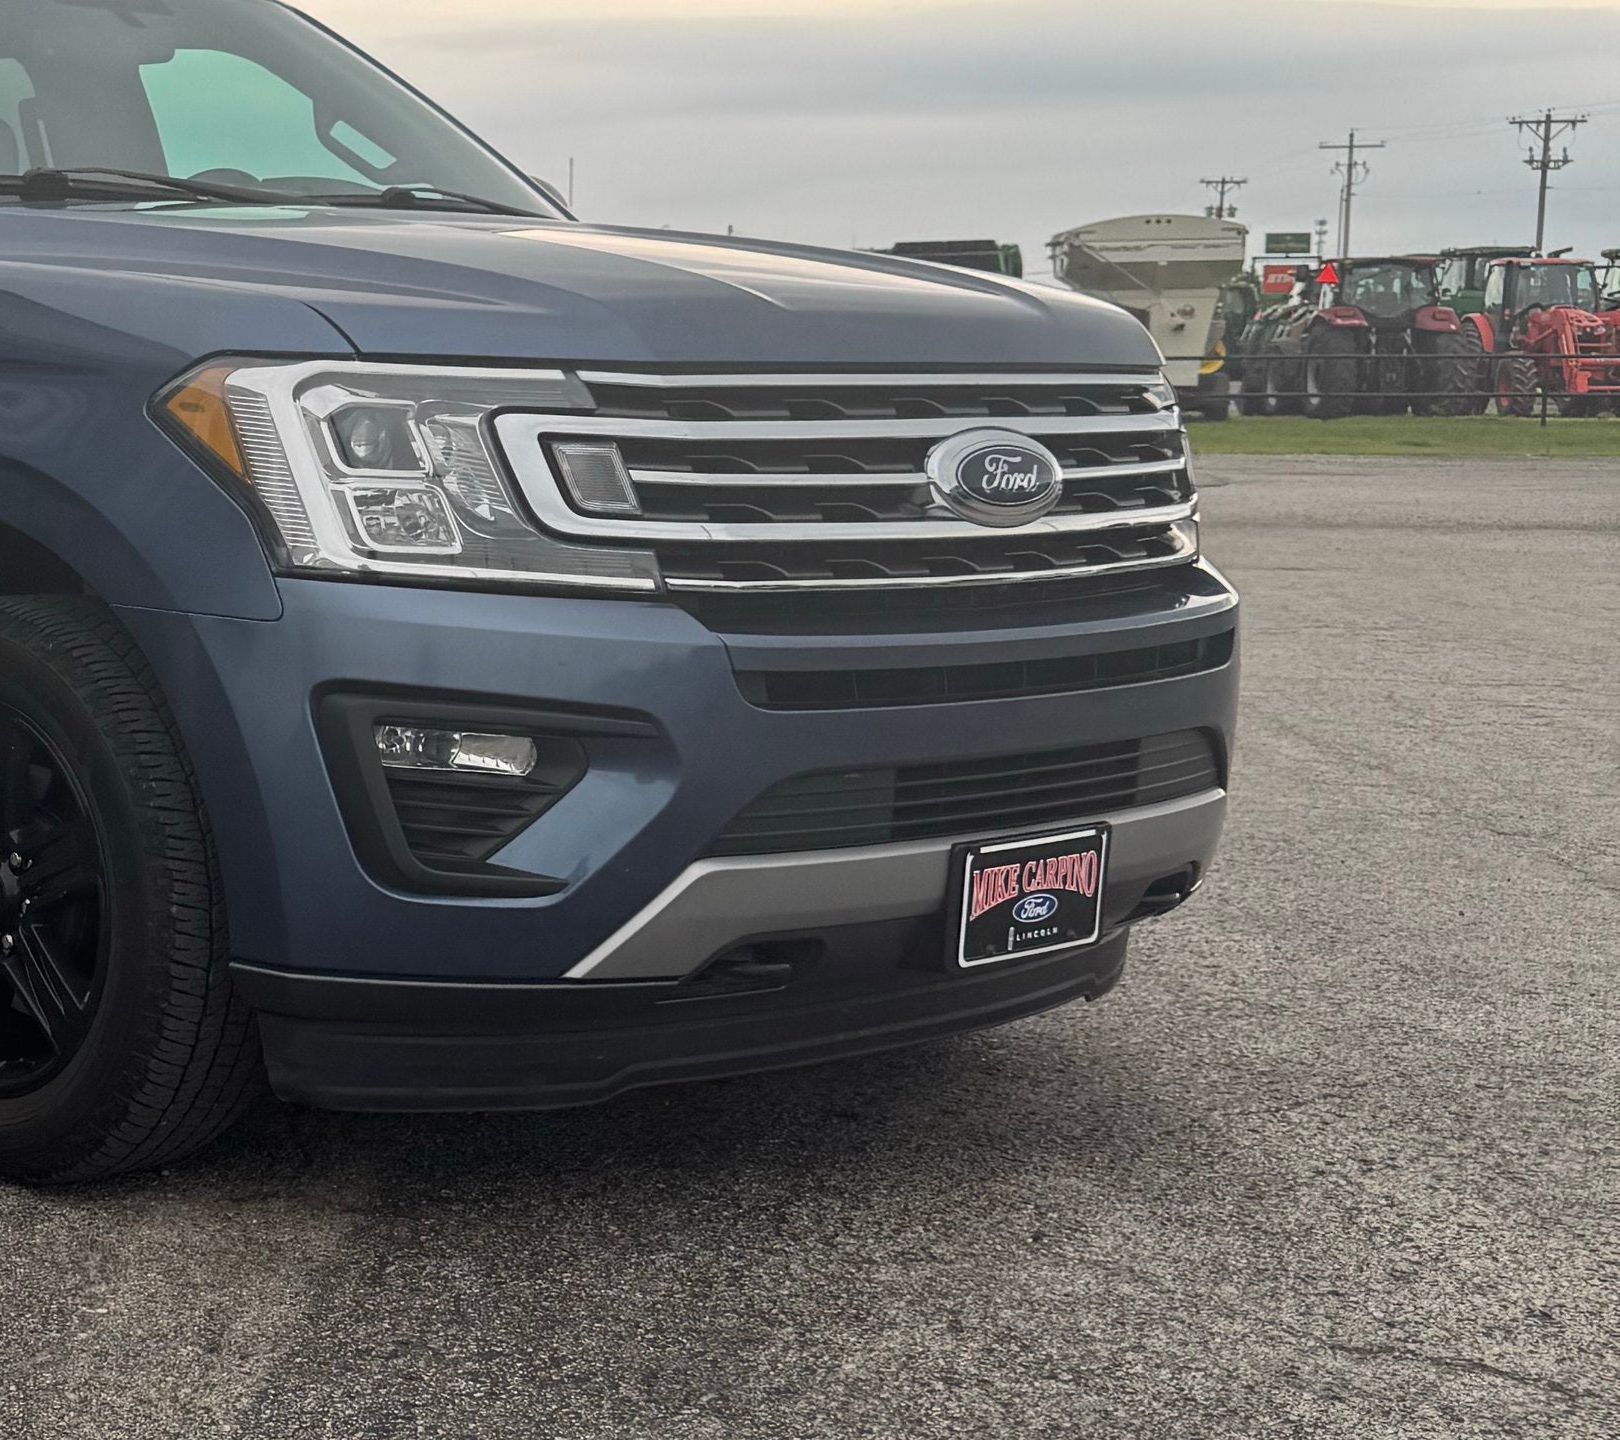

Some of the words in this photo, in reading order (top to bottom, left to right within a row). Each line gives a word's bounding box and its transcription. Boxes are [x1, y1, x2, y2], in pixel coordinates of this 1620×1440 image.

[982, 454, 1039, 493] Ford
[970, 863, 1021, 922] MIKE
[1022, 850, 1098, 898] CARPINO
[1020, 898, 1050, 919] Ford
[1016, 926, 1058, 942] LINCOLN
